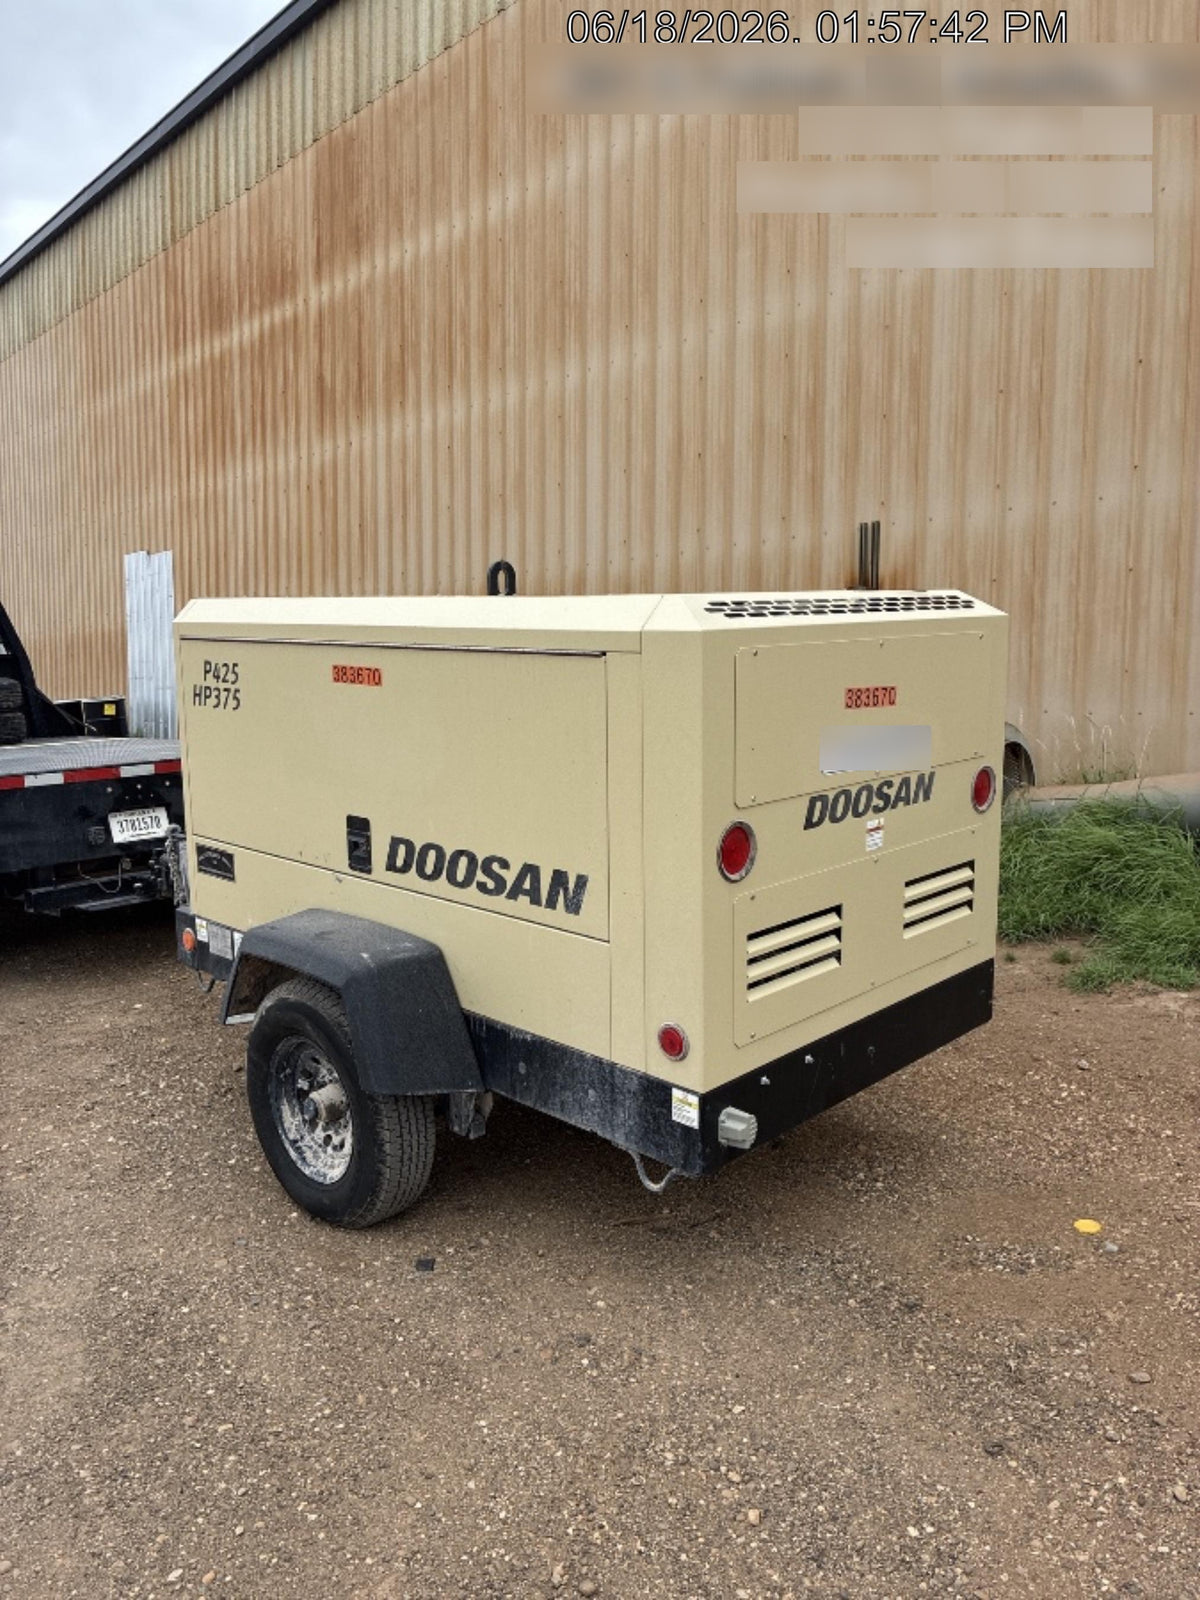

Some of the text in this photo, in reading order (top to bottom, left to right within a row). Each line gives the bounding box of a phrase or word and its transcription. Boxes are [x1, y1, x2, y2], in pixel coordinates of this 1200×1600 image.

[203, 660, 239, 685] P425
[333, 665, 381, 686] 383670
[193, 684, 241, 711] HP375
[846, 687, 896, 708] 383670
[803, 771, 936, 831] DOOSAN
[385, 835, 589, 916] DOOSAN
